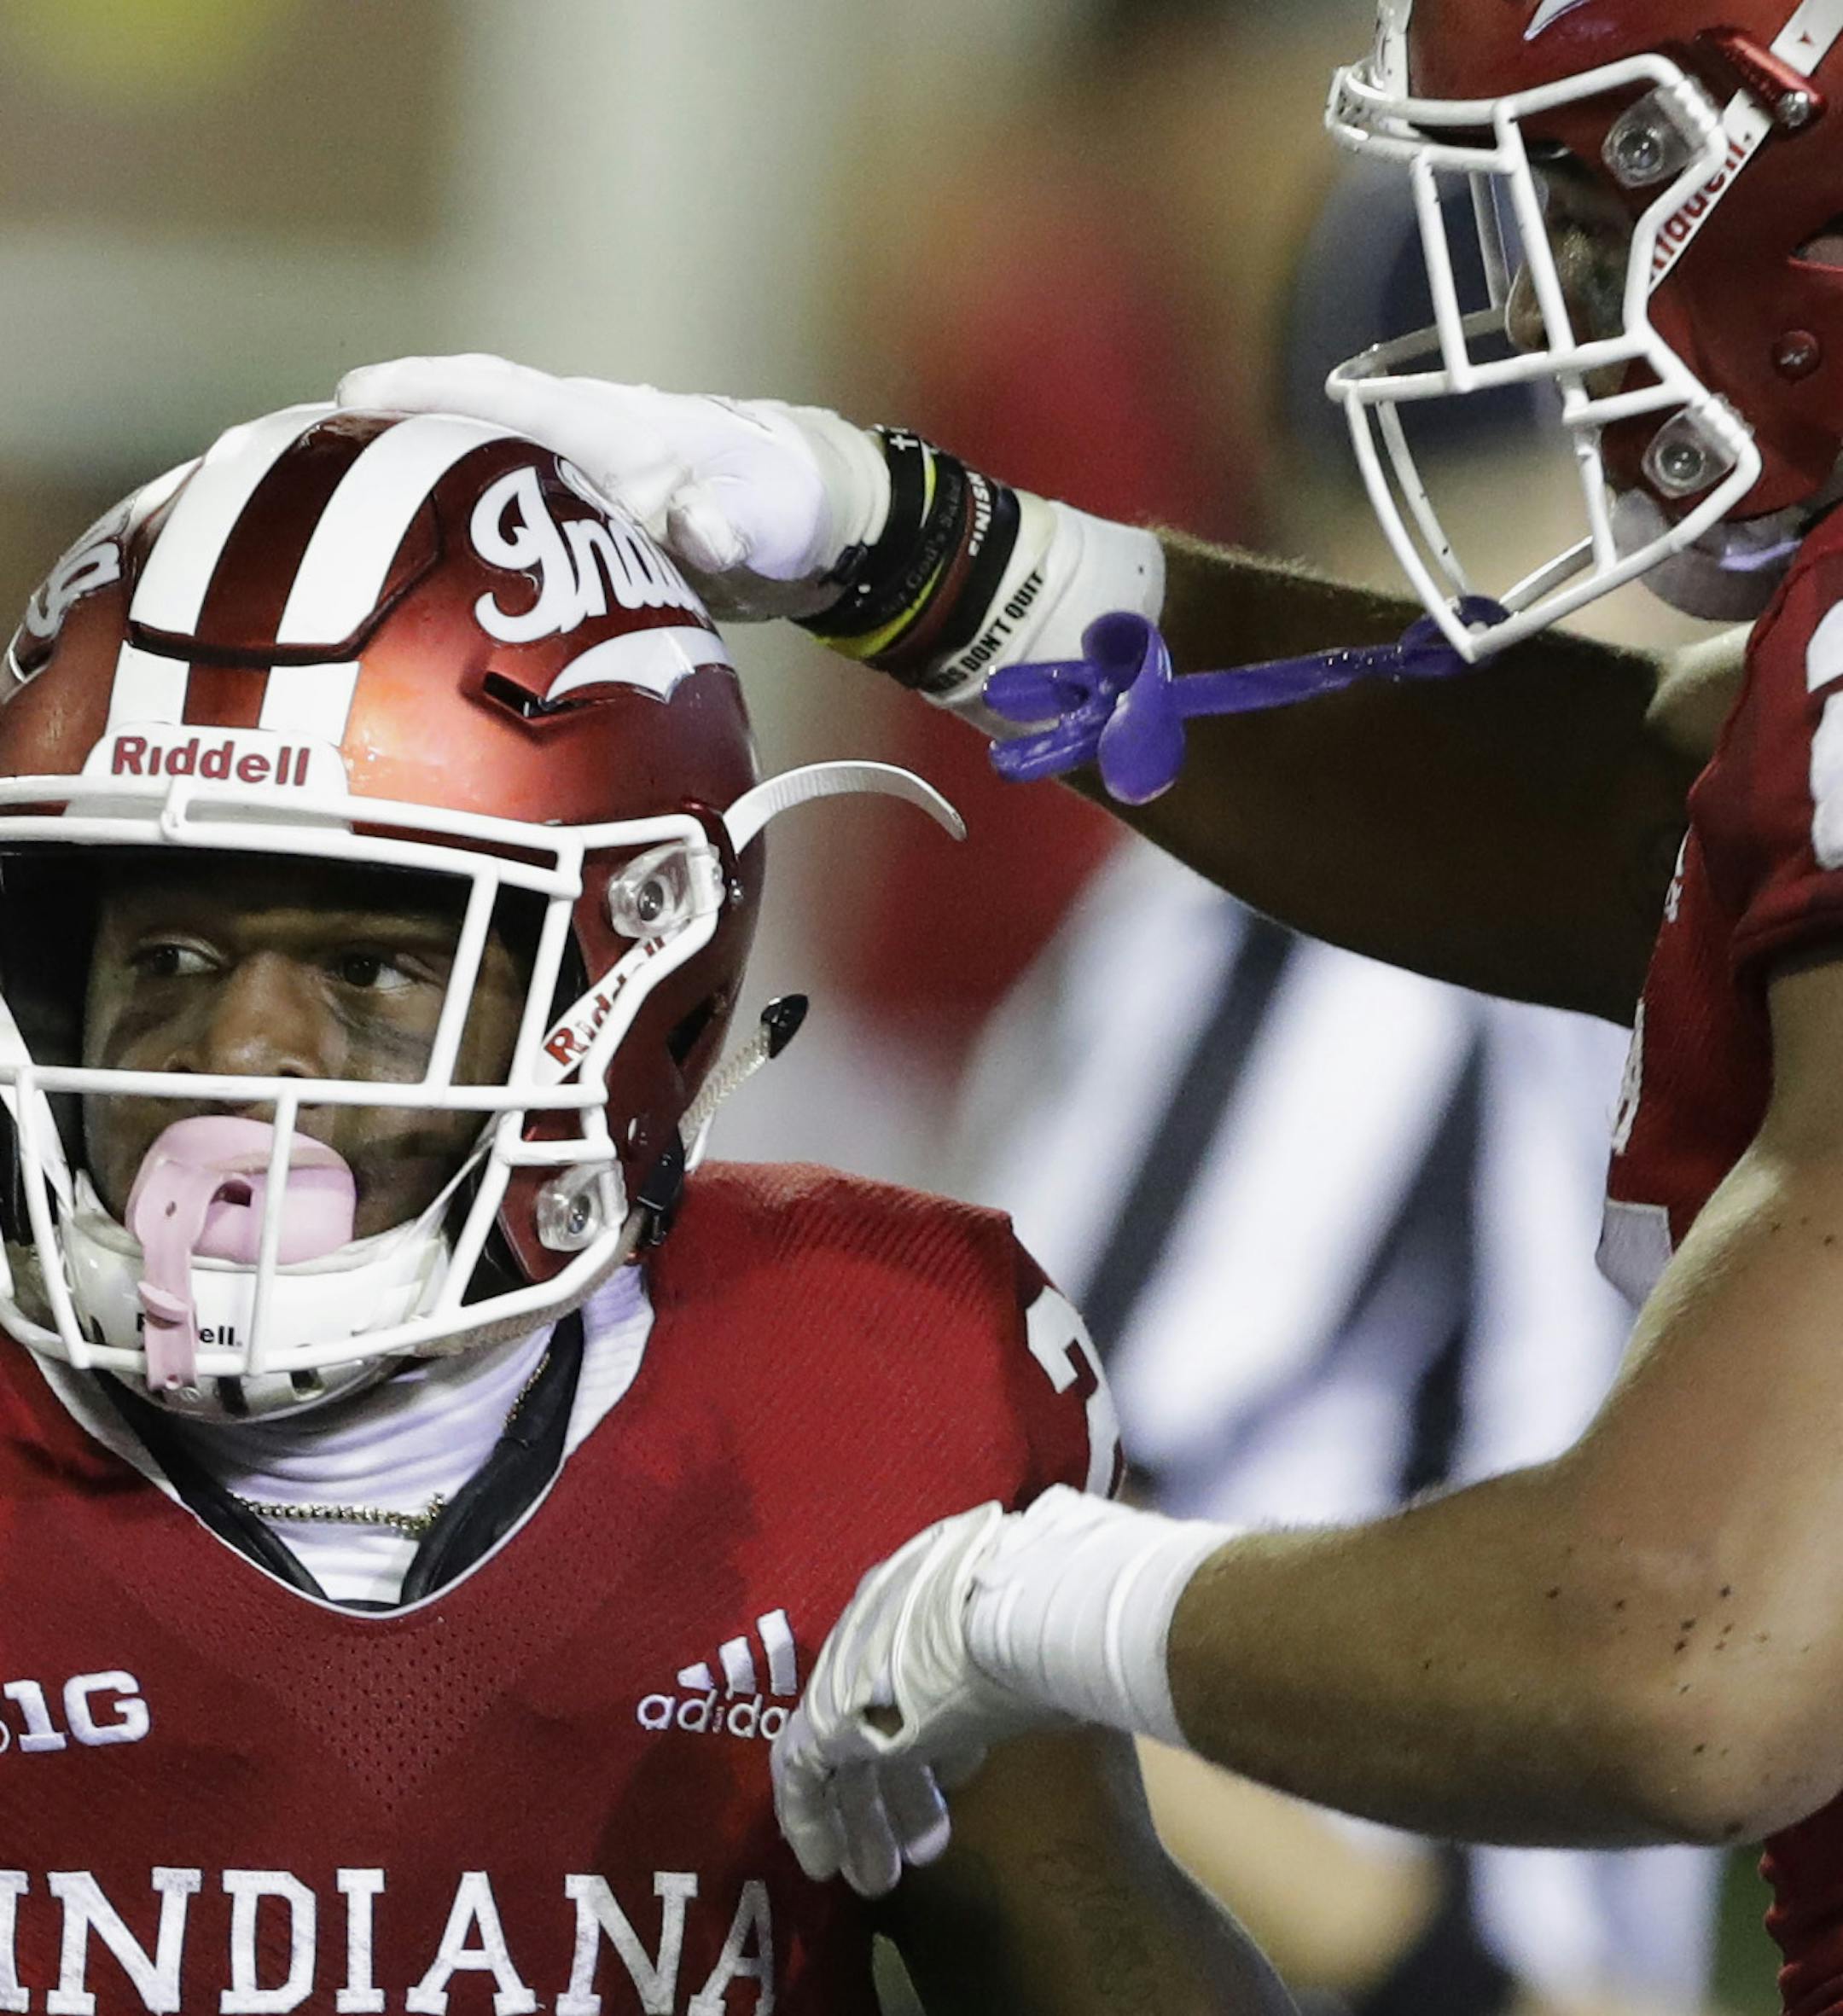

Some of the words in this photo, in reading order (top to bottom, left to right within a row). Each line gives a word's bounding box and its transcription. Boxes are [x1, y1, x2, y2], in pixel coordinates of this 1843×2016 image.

[960, 616, 1012, 672] DON'T
[1004, 571, 1043, 620] QUIT
[112, 736, 311, 786] Riddell
[0, 1670, 149, 1755] 1G
[637, 1688, 790, 1740] adida
[0, 1866, 775, 2016] INDIANA
